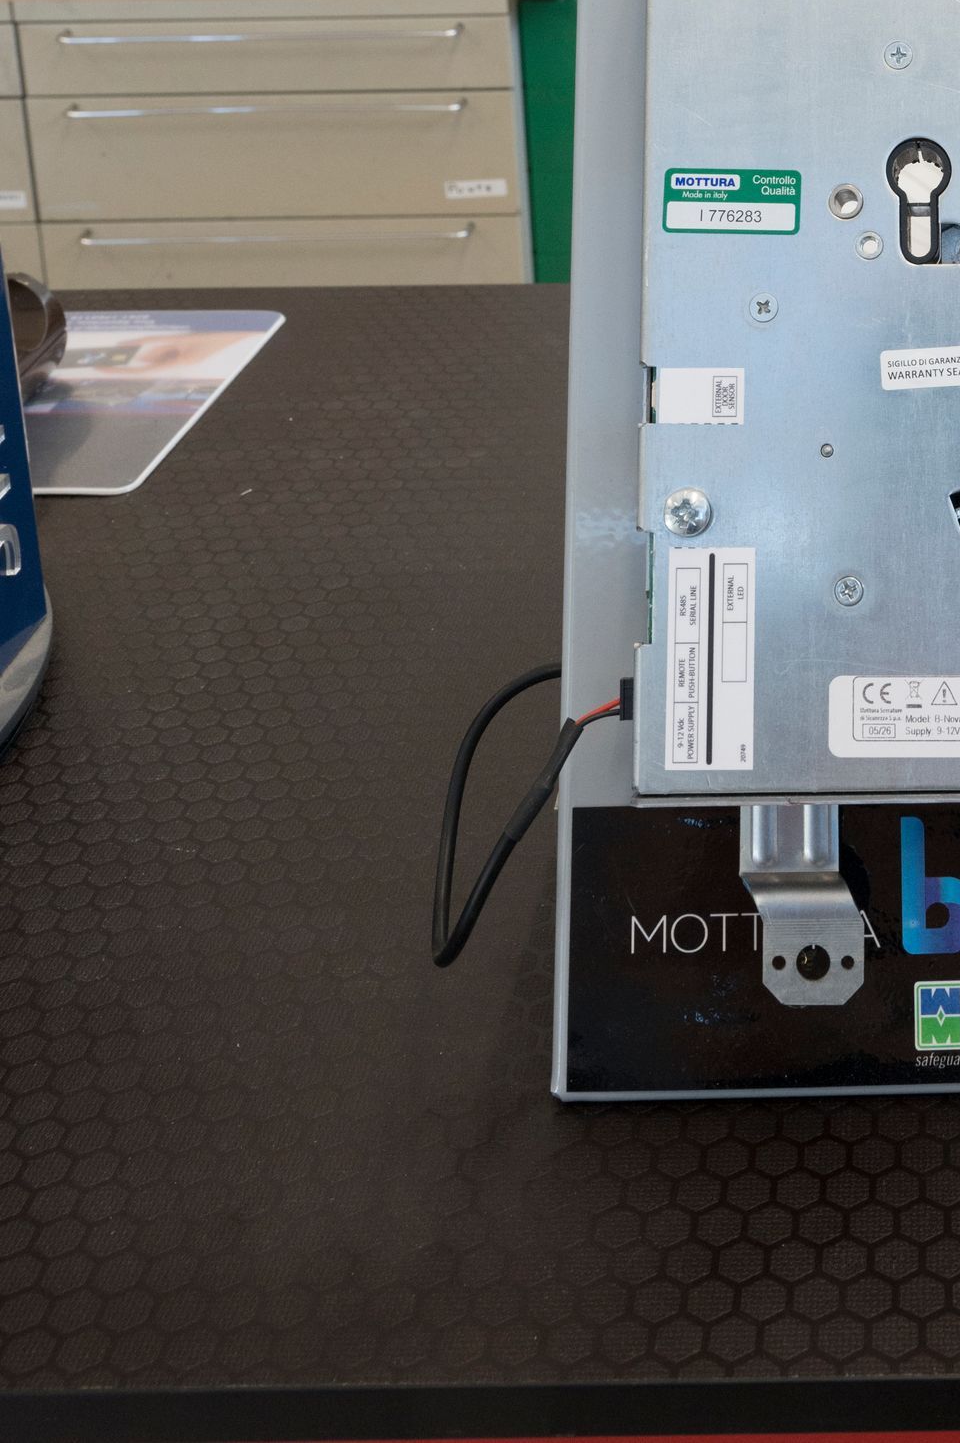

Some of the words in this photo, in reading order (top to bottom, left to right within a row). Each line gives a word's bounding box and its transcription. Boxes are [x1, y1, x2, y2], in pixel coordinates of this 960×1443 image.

[675, 177, 736, 187] MOTTURA
[752, 175, 797, 185] Controllo
[761, 186, 796, 196] Qualità
[708, 209, 762, 223] 776283
[887, 358, 916, 368] SIGILLO
[918, 358, 927, 366] DI
[887, 368, 945, 381] WARRANTY
[715, 379, 723, 414] EXTERNAL
[722, 386, 730, 408] DOOR
[727, 575, 735, 611] EXTERNAL
[737, 586, 745, 600] LED
[679, 595, 687, 617] RS485
[689, 602, 697, 626] SERIAL
[678, 658, 686, 688] REMOTE
[688, 646, 697, 699] PUSH-BUTTON
[678, 717, 686, 731] Vdc
[688, 705, 697, 732] SUPPLY
[868, 727, 892, 736] 05/26
[936, 727, 960, 736] 9-12V
[678, 731, 686, 749] 9-12
[687, 732, 696, 760] POWER
